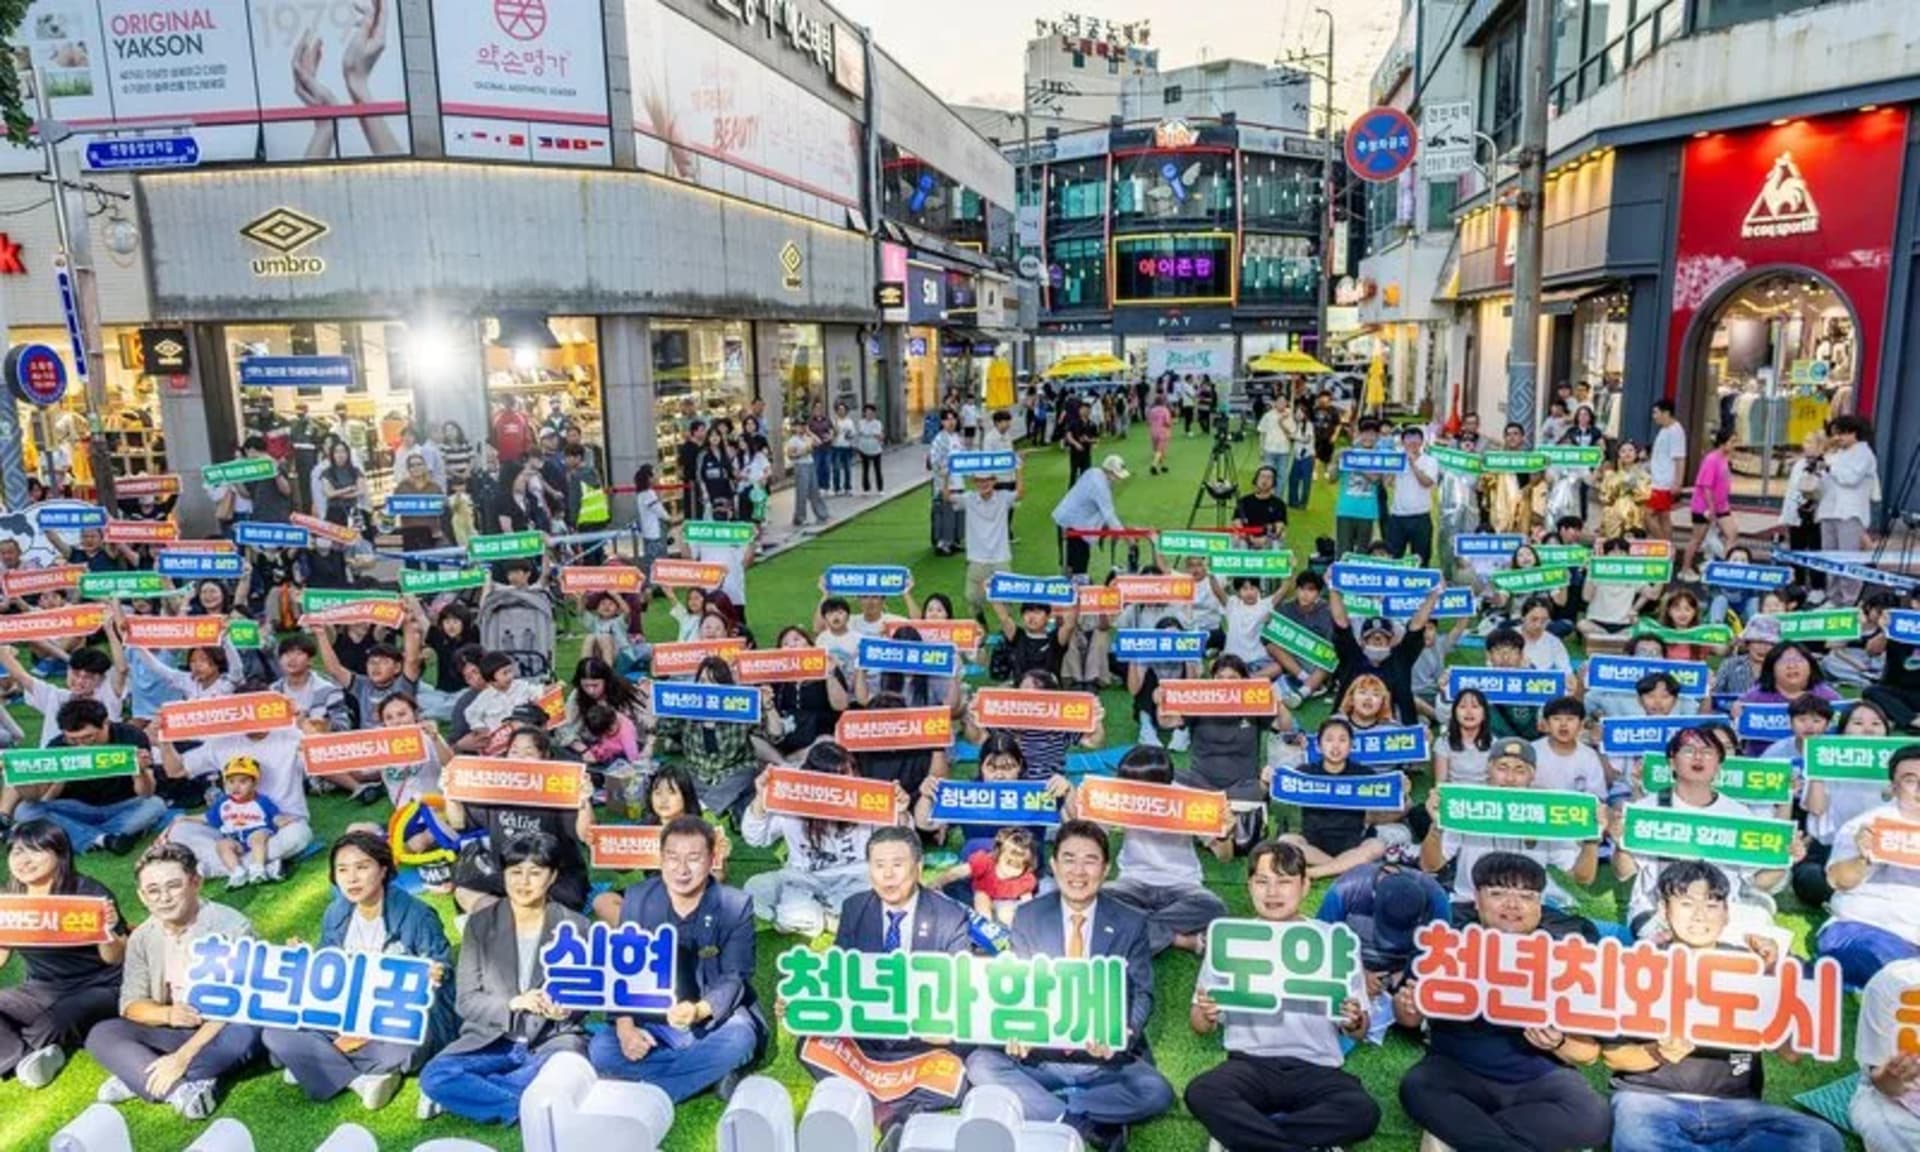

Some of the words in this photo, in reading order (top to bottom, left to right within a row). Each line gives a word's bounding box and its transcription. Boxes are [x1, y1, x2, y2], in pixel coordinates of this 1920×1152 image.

[112, 9, 217, 35] ORIGINAL
[114, 34, 204, 58] YAKSON
[476, 43, 567, 77] 약손명가
[253, 255, 323, 274] umbro
[662, 691, 702, 708] 청년의
[1612, 728, 1662, 744] 청년의
[12, 756, 58, 773] 청년과
[62, 753, 92, 771] 함께
[95, 752, 126, 769] 도약
[1816, 746, 1873, 769] 청년과
[454, 769, 543, 792] 청년친화도시
[546, 774, 578, 794] 순천
[1281, 777, 1330, 793] 청년의
[1357, 783, 1391, 797] 실현
[1747, 771, 1784, 790] 도약
[773, 780, 858, 808] 청년친화도시
[860, 793, 890, 812] 순천
[941, 788, 995, 809] 청년의
[1000, 790, 1018, 810] 꿈
[1090, 789, 1183, 819] 청년친화도시
[1185, 801, 1218, 822] 순천
[1447, 800, 1503, 821] 청년과
[1508, 803, 1546, 824] 함께
[1549, 803, 1588, 827] 도약
[601, 836, 660, 856] 청년친화
[1634, 820, 1692, 843] 청년과
[1696, 827, 1737, 848] 함께
[1741, 831, 1782, 853] 도약
[1881, 831, 1920, 850] 청년
[0, 910, 58, 931] 화도시
[61, 909, 98, 931] 순천
[543, 923, 673, 1008] 실현
[1207, 921, 1358, 1017] 도약
[189, 938, 365, 1033] 청년의
[369, 956, 431, 1042] 꿈
[780, 949, 978, 1040] 청년과
[986, 955, 1124, 1048] 함께
[1416, 922, 1837, 1057] 청년친화도시
